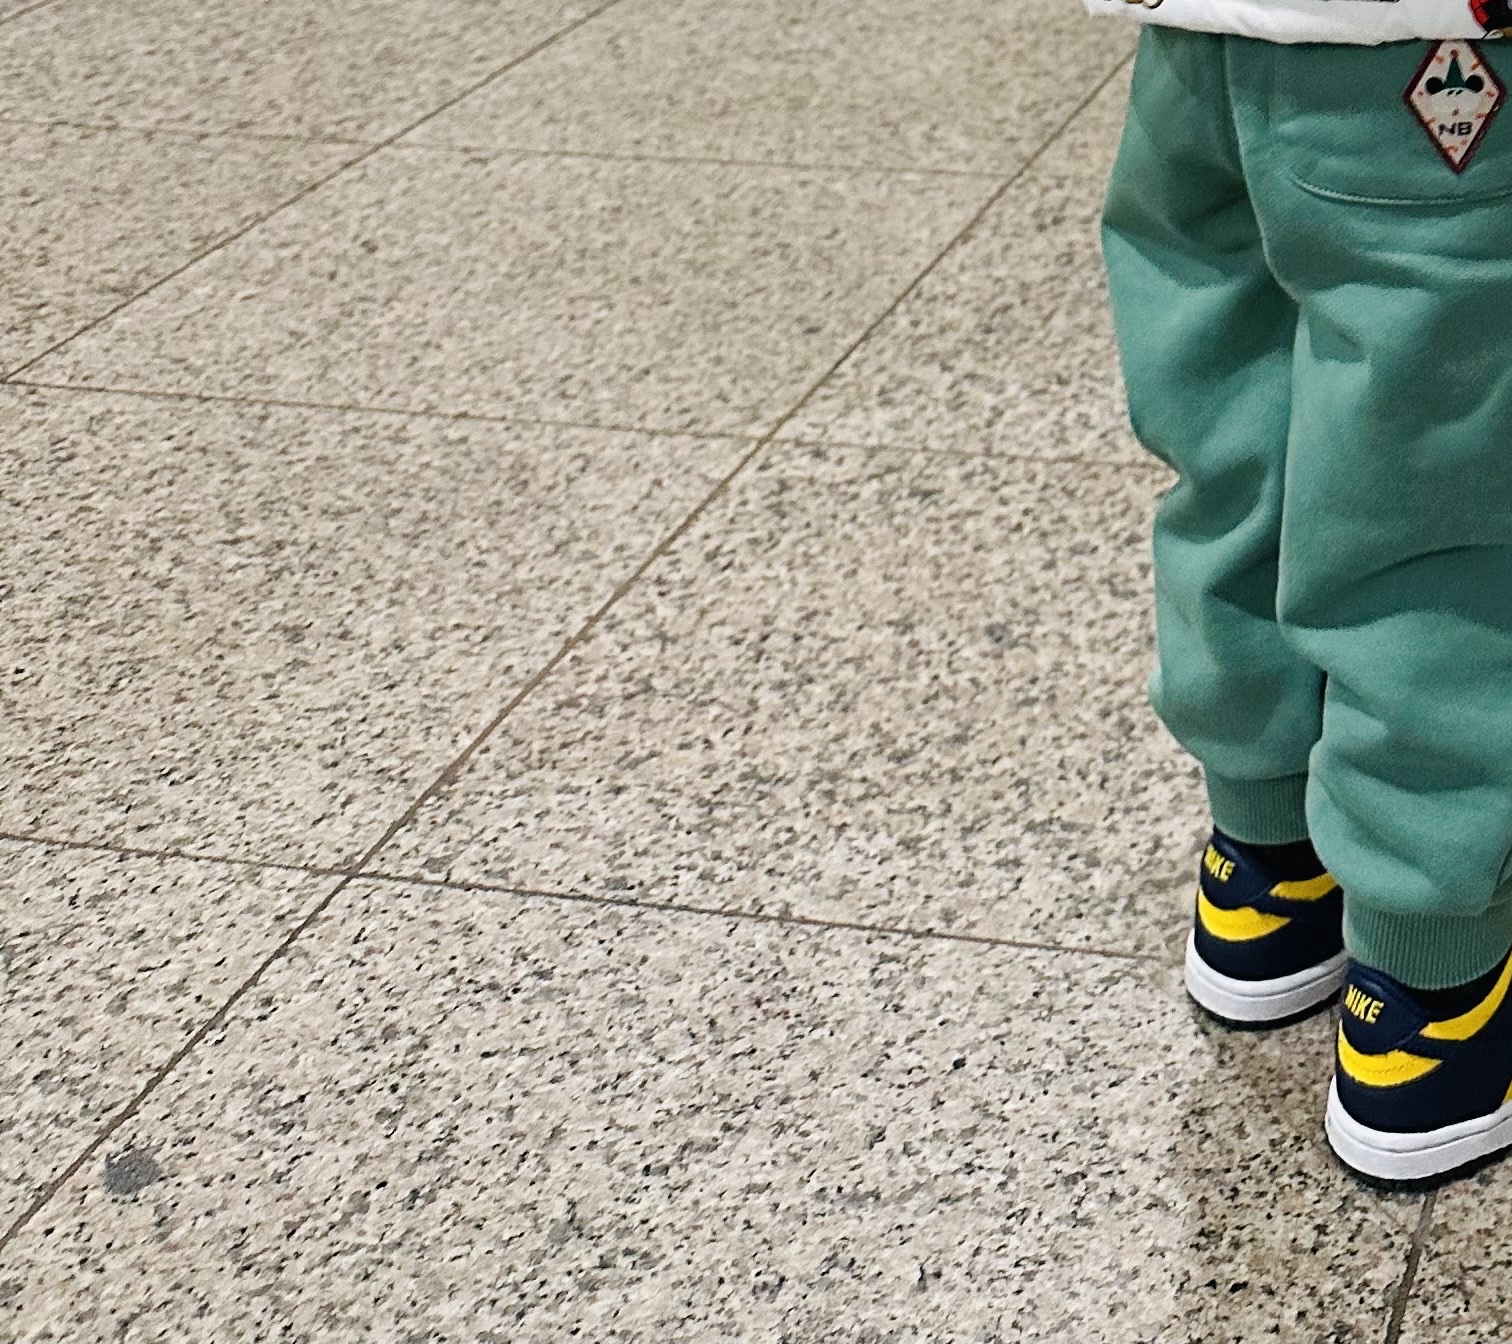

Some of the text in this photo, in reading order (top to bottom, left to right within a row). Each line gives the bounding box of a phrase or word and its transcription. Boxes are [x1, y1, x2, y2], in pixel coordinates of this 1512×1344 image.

[1438, 121, 1474, 137] NB
[1203, 844, 1236, 883] NIKE
[1344, 983, 1385, 1025] NIKE
